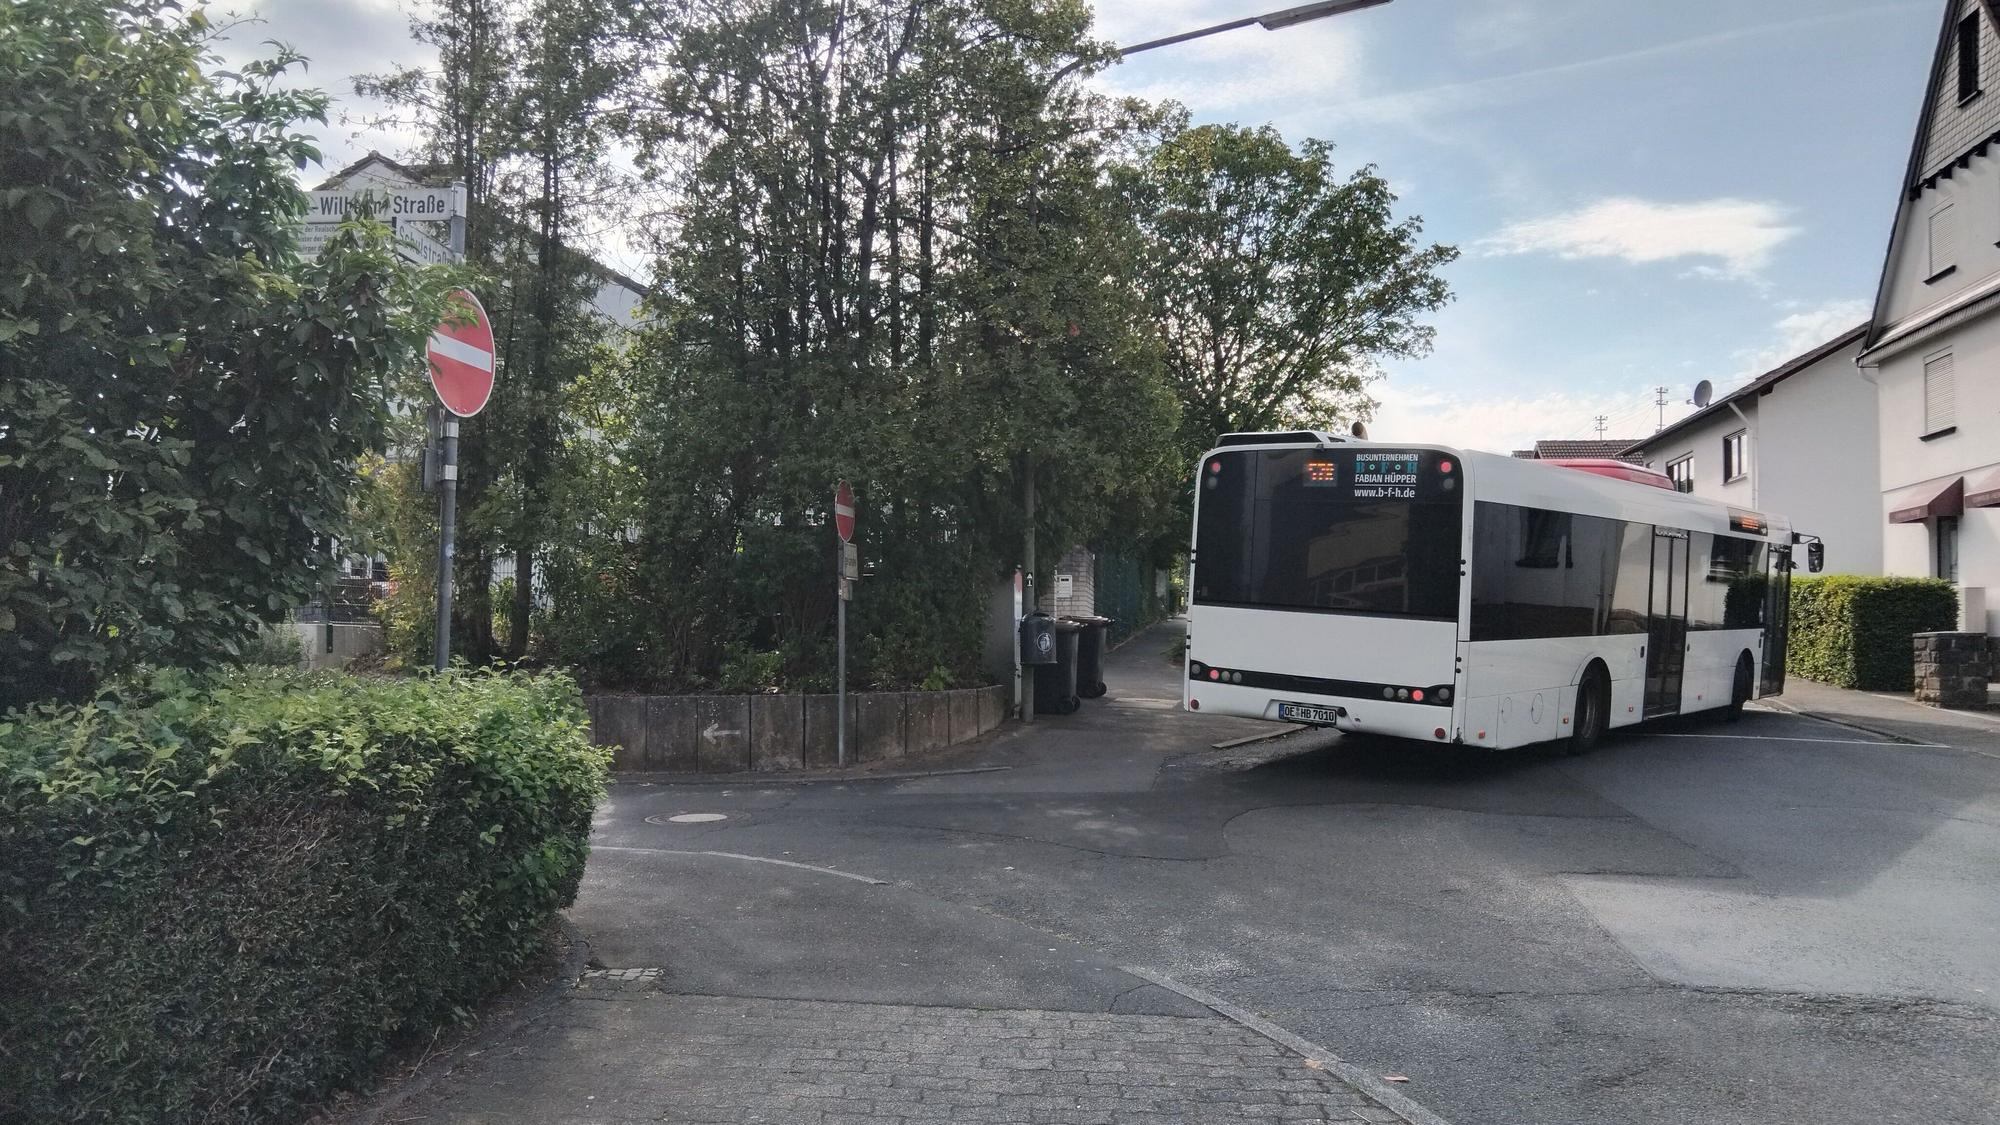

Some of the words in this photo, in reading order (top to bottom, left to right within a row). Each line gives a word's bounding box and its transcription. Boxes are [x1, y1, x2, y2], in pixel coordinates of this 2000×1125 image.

[393, 194, 445, 215] Straße
[1356, 453, 1418, 461] BUSUNTERNEHMEN
[1355, 474, 1383, 483] FABIAN
[1384, 472, 1417, 483] HÜPPER
[1354, 487, 1416, 498] www.b-f-h.de
[1284, 706, 1295, 717] OE
[1300, 708, 1312, 719] HB
[1313, 710, 1334, 722] 7010
